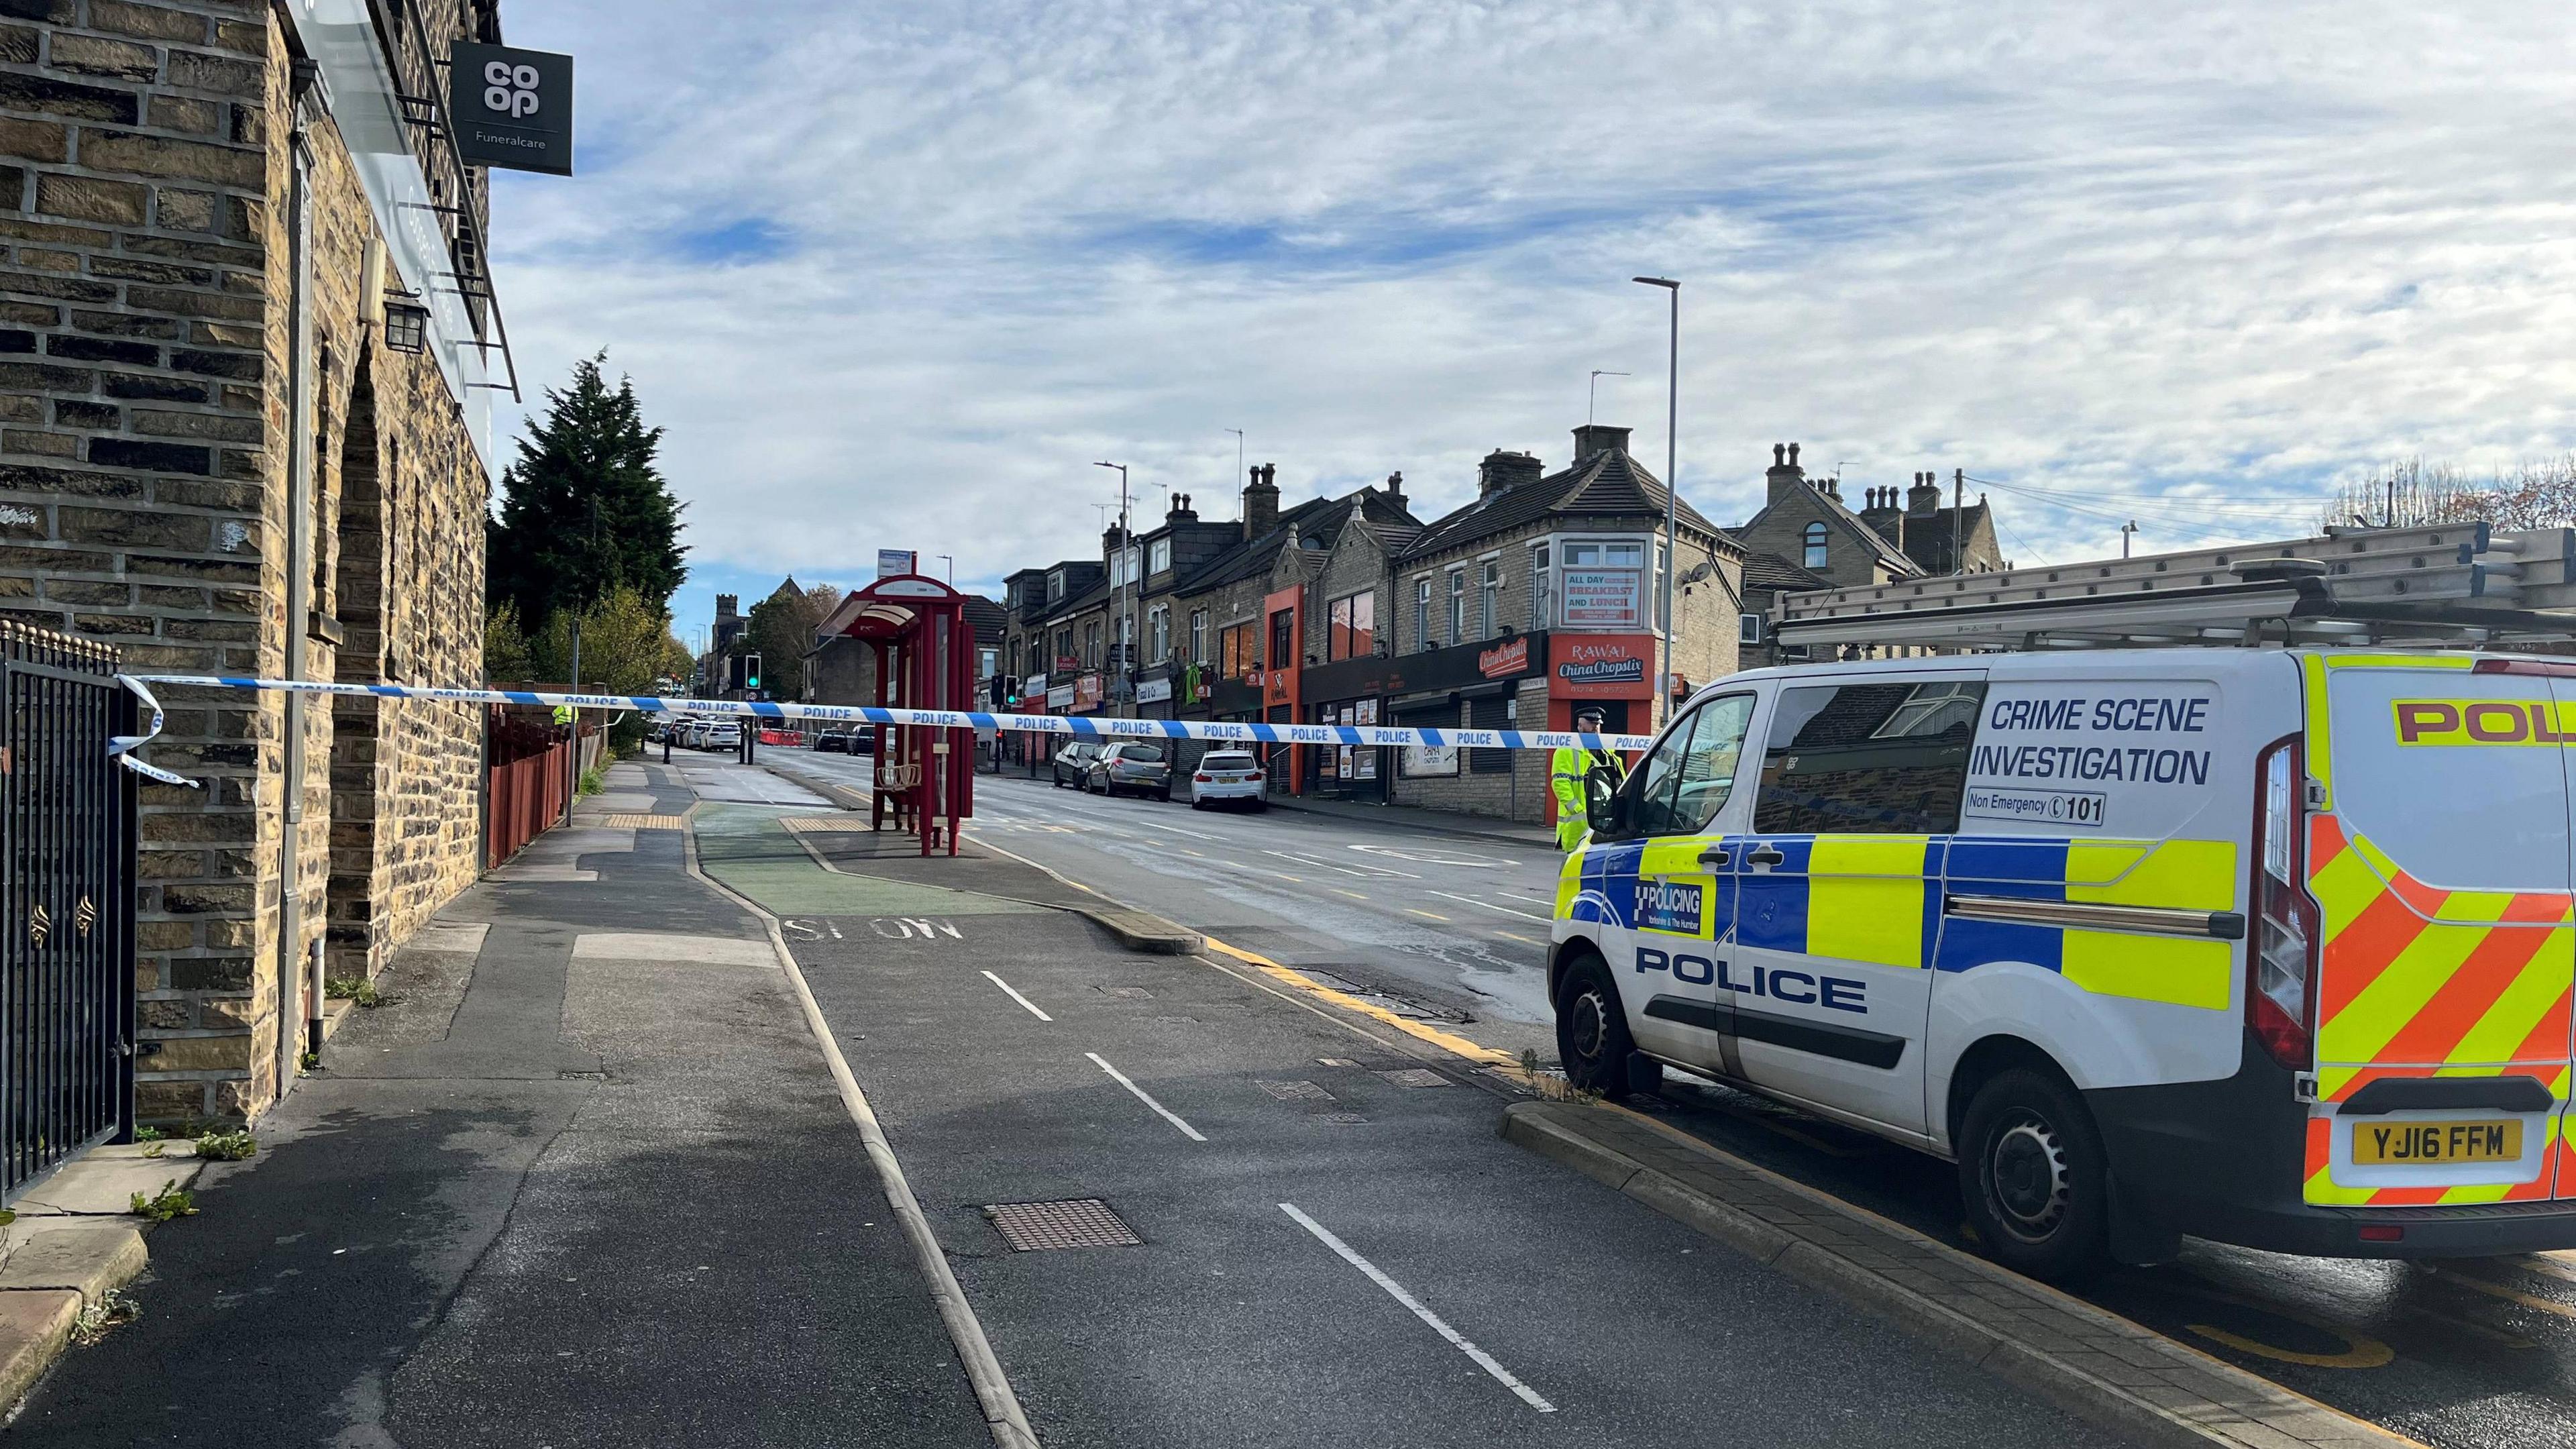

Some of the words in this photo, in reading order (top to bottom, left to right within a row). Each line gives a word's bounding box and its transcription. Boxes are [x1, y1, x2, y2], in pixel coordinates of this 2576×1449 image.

[476, 131, 546, 150] Funeralcare
[1590, 598, 1628, 606] LUNCH
[1572, 644, 1630, 660] RAWAL
[687, 701, 738, 712] POLICE
[804, 707, 851, 719] POLICE
[912, 712, 958, 725] POLICE
[1992, 700, 2086, 731] CRIME
[2092, 699, 2210, 732] SCENE
[1015, 717, 1058, 731] POLICE
[1112, 721, 1152, 735] POLICE
[1203, 724, 1242, 738] POLICE
[1291, 728, 1328, 741] POLICE
[1375, 730, 1411, 743] POLICE
[1457, 733, 1491, 745] POLICE
[1537, 735, 1571, 746] POLICE
[1615, 737, 1650, 748] POLICE
[1972, 746, 2210, 785] INVESTIGATION
[1970, 794, 1988, 808] Non
[1991, 795, 2047, 815] Emergency
[2068, 797, 2102, 821] 101
[1649, 886, 1700, 914] POLICING
[1648, 914, 1667, 926] Yorkshire
[1668, 918, 1670, 926] &
[1672, 918, 1680, 928] The
[1680, 919, 1699, 930] Humber
[1635, 947, 1868, 1014] POLICE
[2374, 1127, 2440, 1159] YJ16
[2449, 1125, 2504, 1157] FFM
